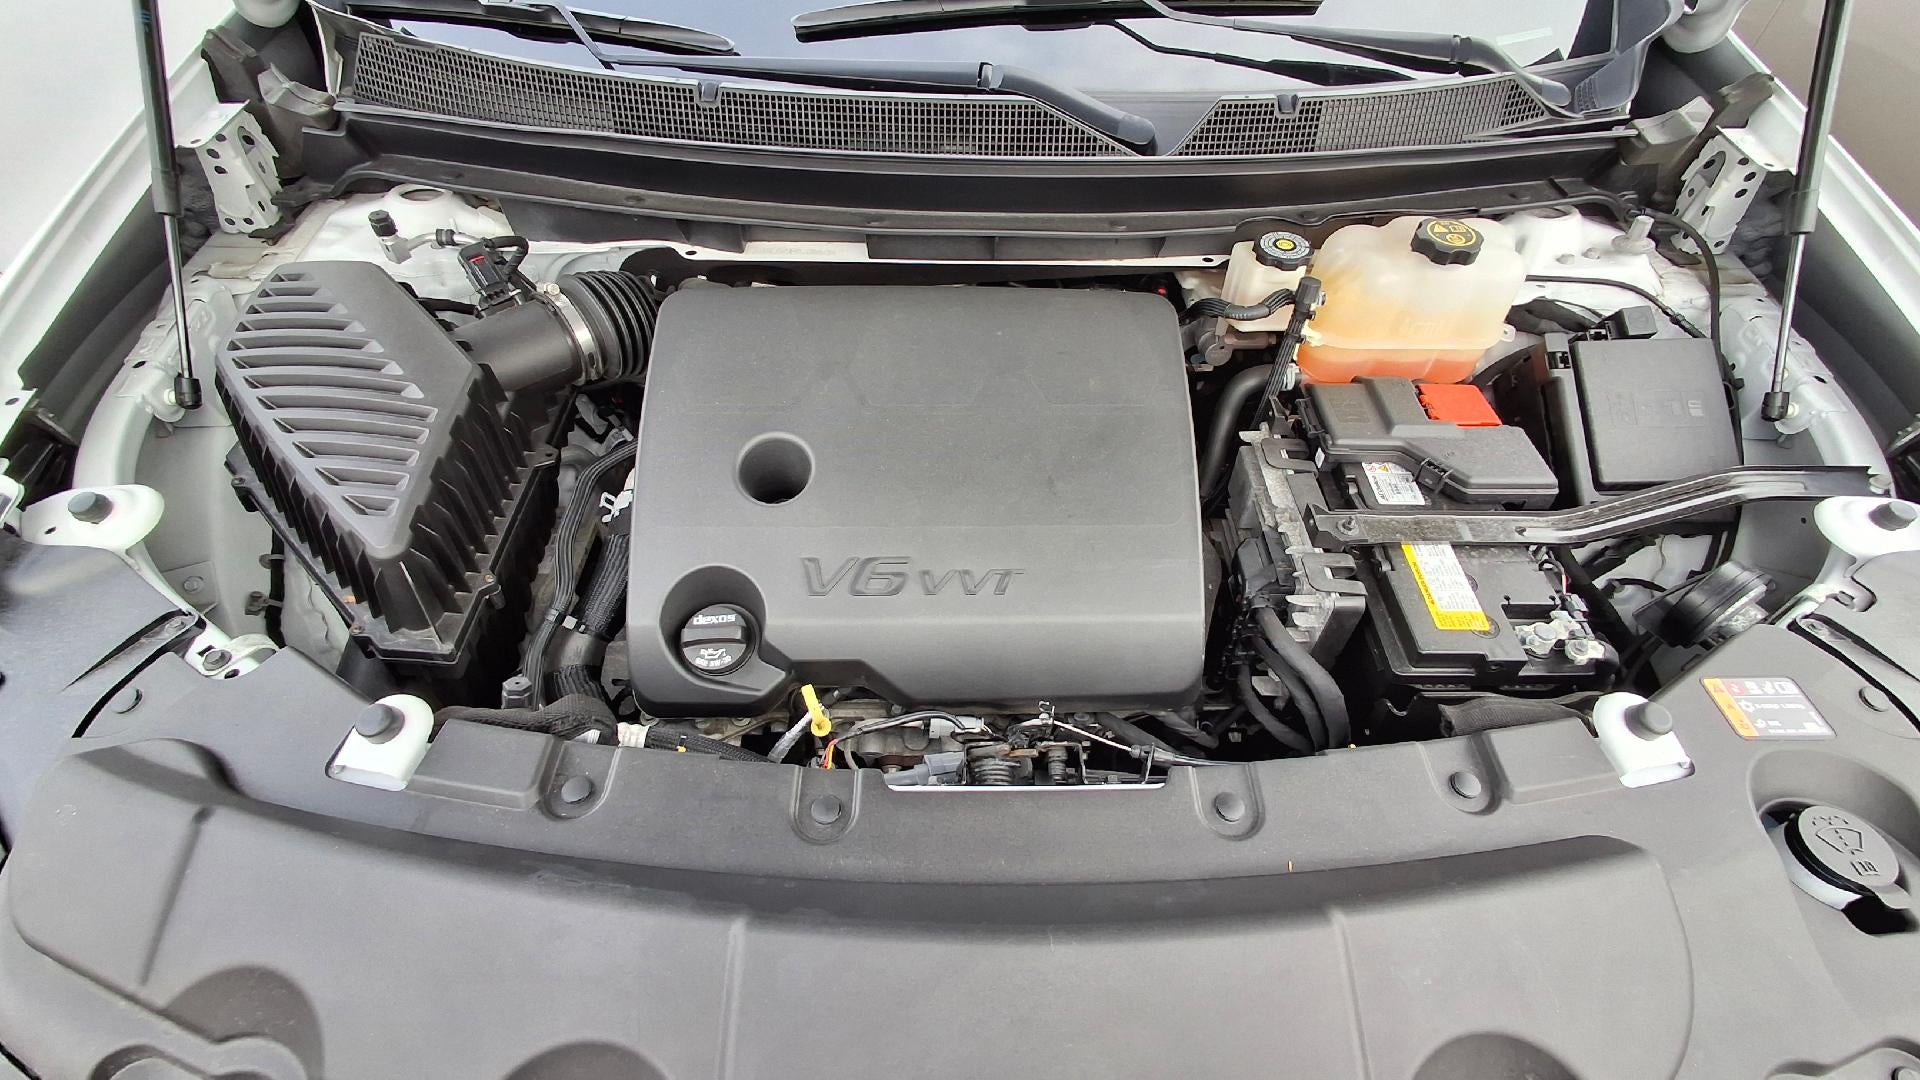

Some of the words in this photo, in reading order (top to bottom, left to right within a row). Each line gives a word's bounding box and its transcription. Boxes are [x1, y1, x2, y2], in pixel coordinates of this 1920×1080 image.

[800, 556, 911, 596] V6
[918, 568, 1025, 596] VVT
[693, 614, 736, 625] dexos
